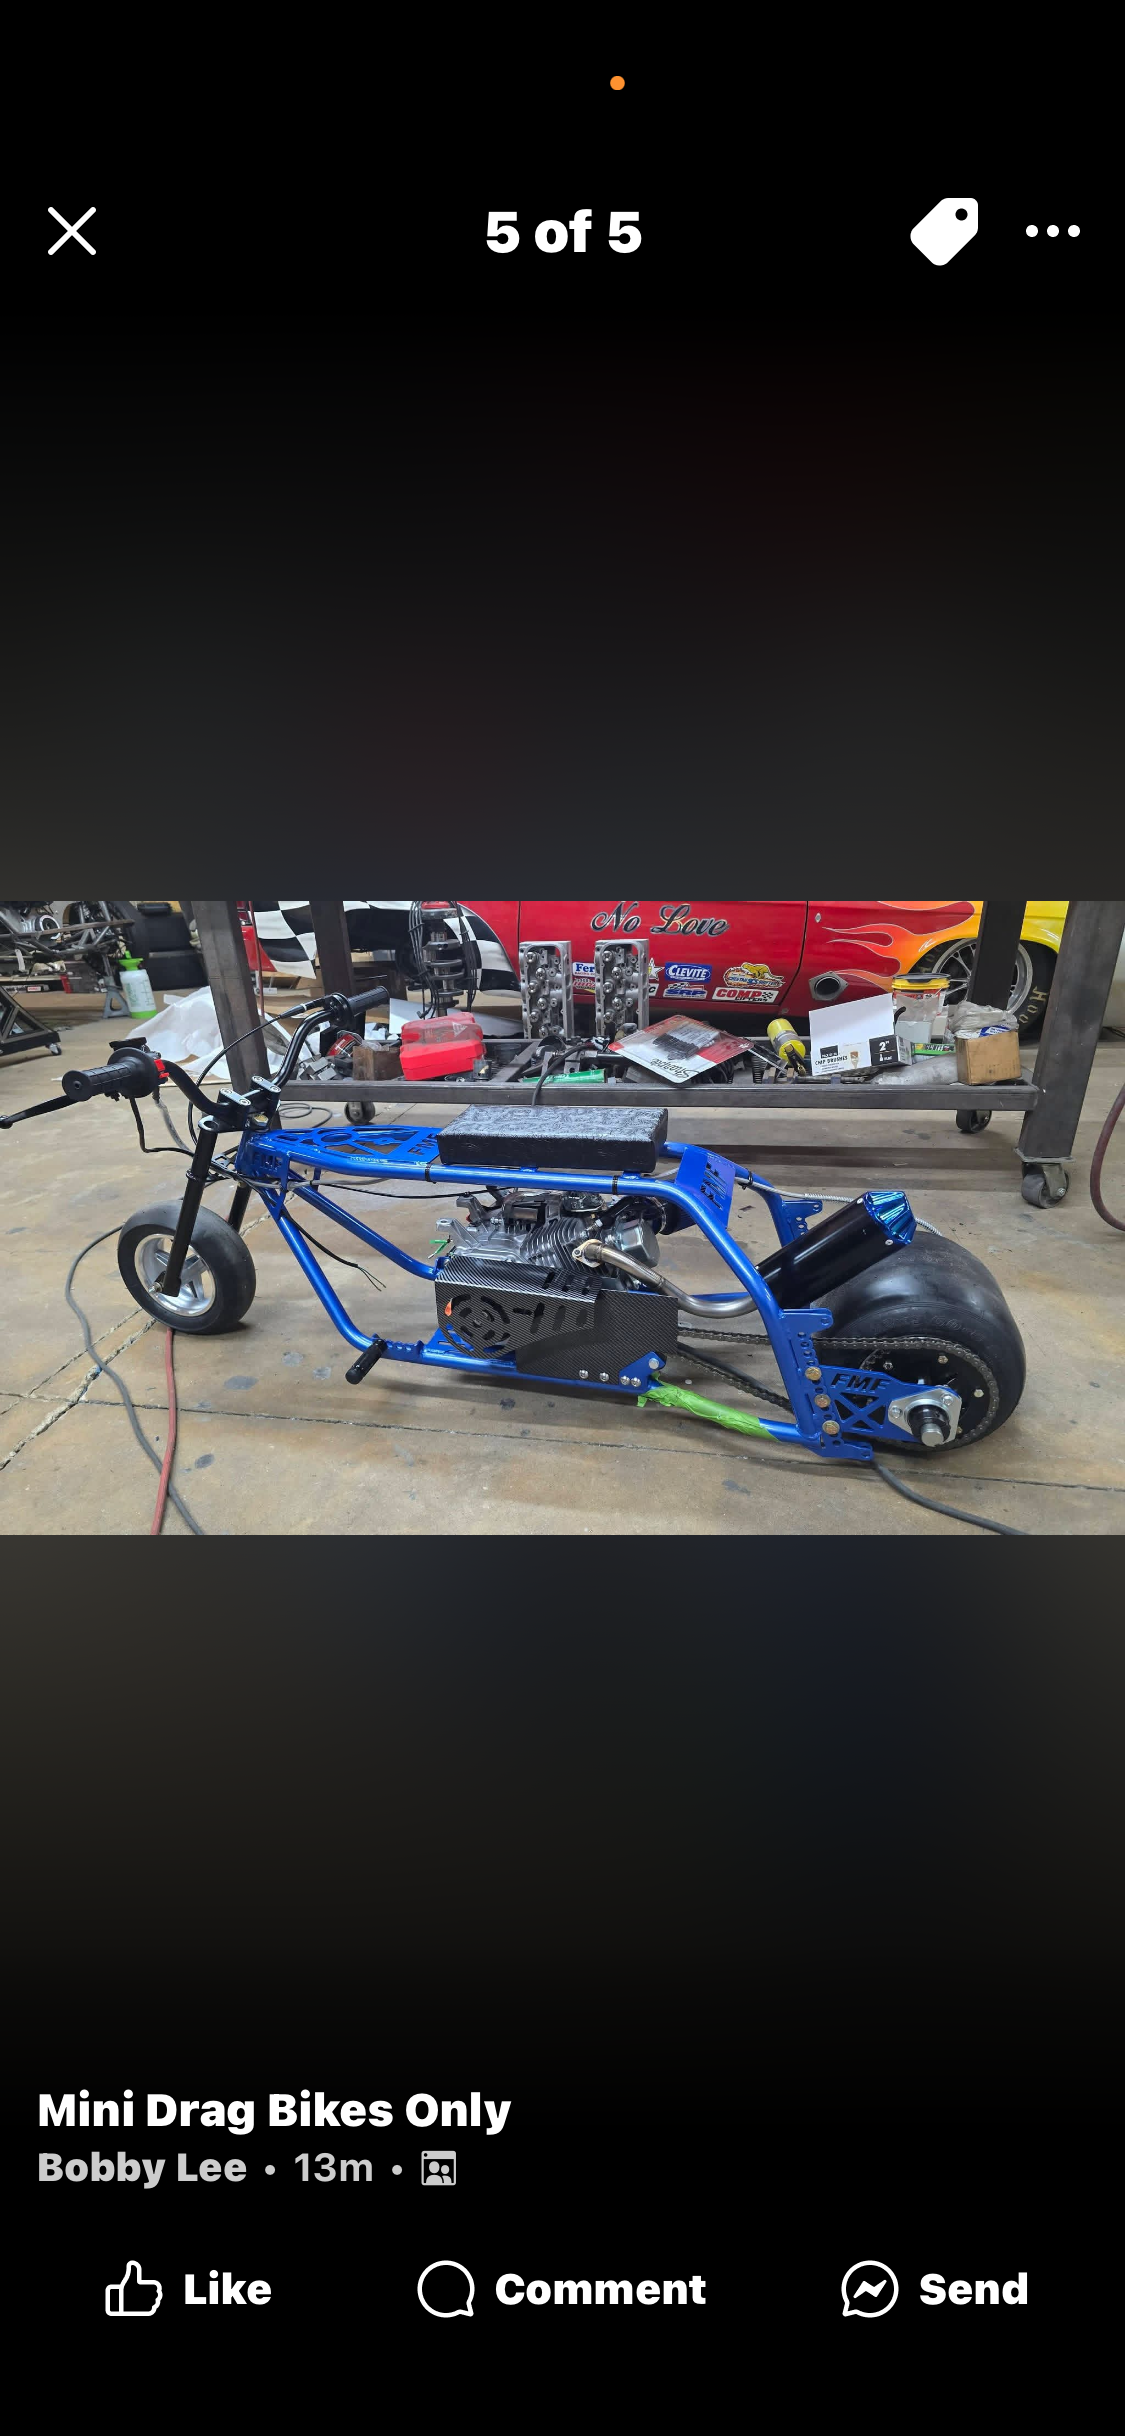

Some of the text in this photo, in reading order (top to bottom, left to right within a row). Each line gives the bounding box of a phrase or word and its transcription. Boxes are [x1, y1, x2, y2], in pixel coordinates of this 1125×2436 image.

[590, 901, 729, 937] No Love
[575, 963, 595, 973] Fer
[668, 964, 707, 978] CLEVITE
[665, 988, 707, 996] SRP
[716, 988, 763, 998] COMP
[830, 1372, 892, 1393] FMF
